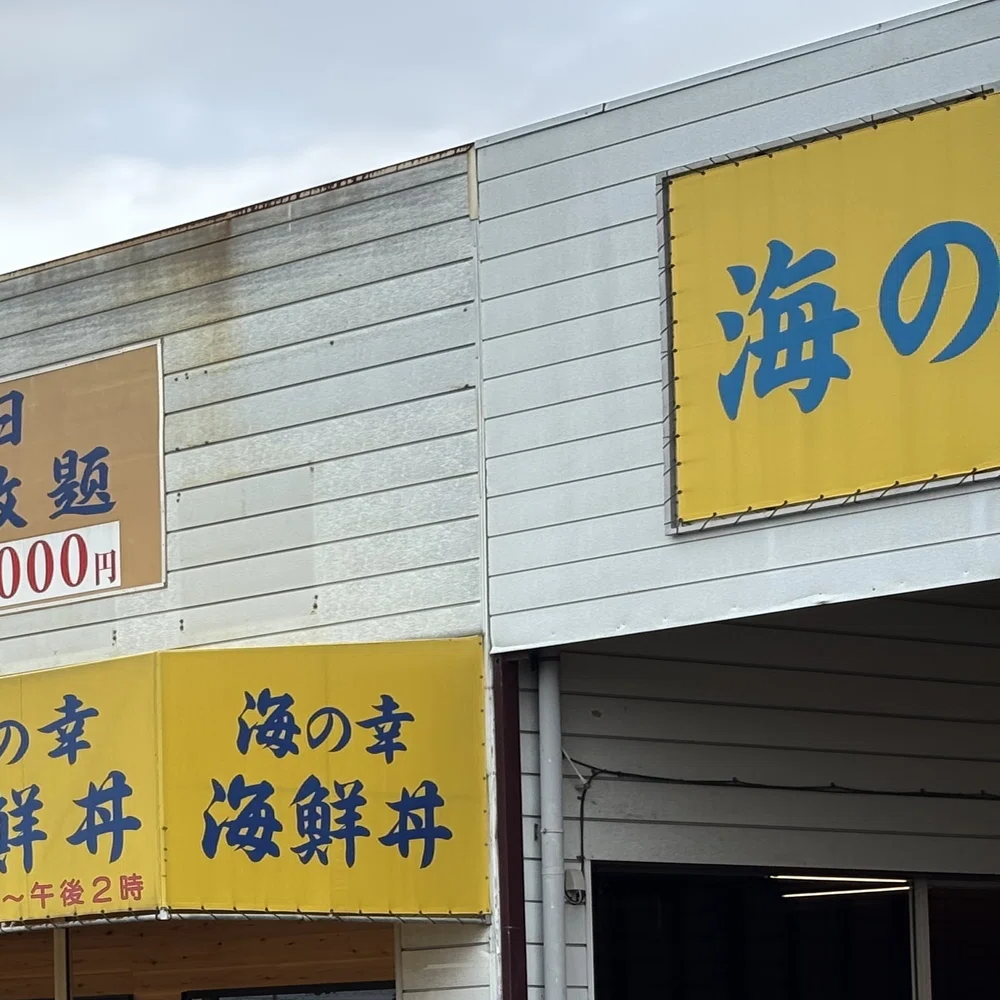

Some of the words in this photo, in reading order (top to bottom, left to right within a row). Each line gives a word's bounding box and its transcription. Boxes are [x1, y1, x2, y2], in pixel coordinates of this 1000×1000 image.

[716, 220, 1000, 421] 海の
[236, 688, 416, 765] 海の幸
[201, 774, 453, 869] 海鮮丼
